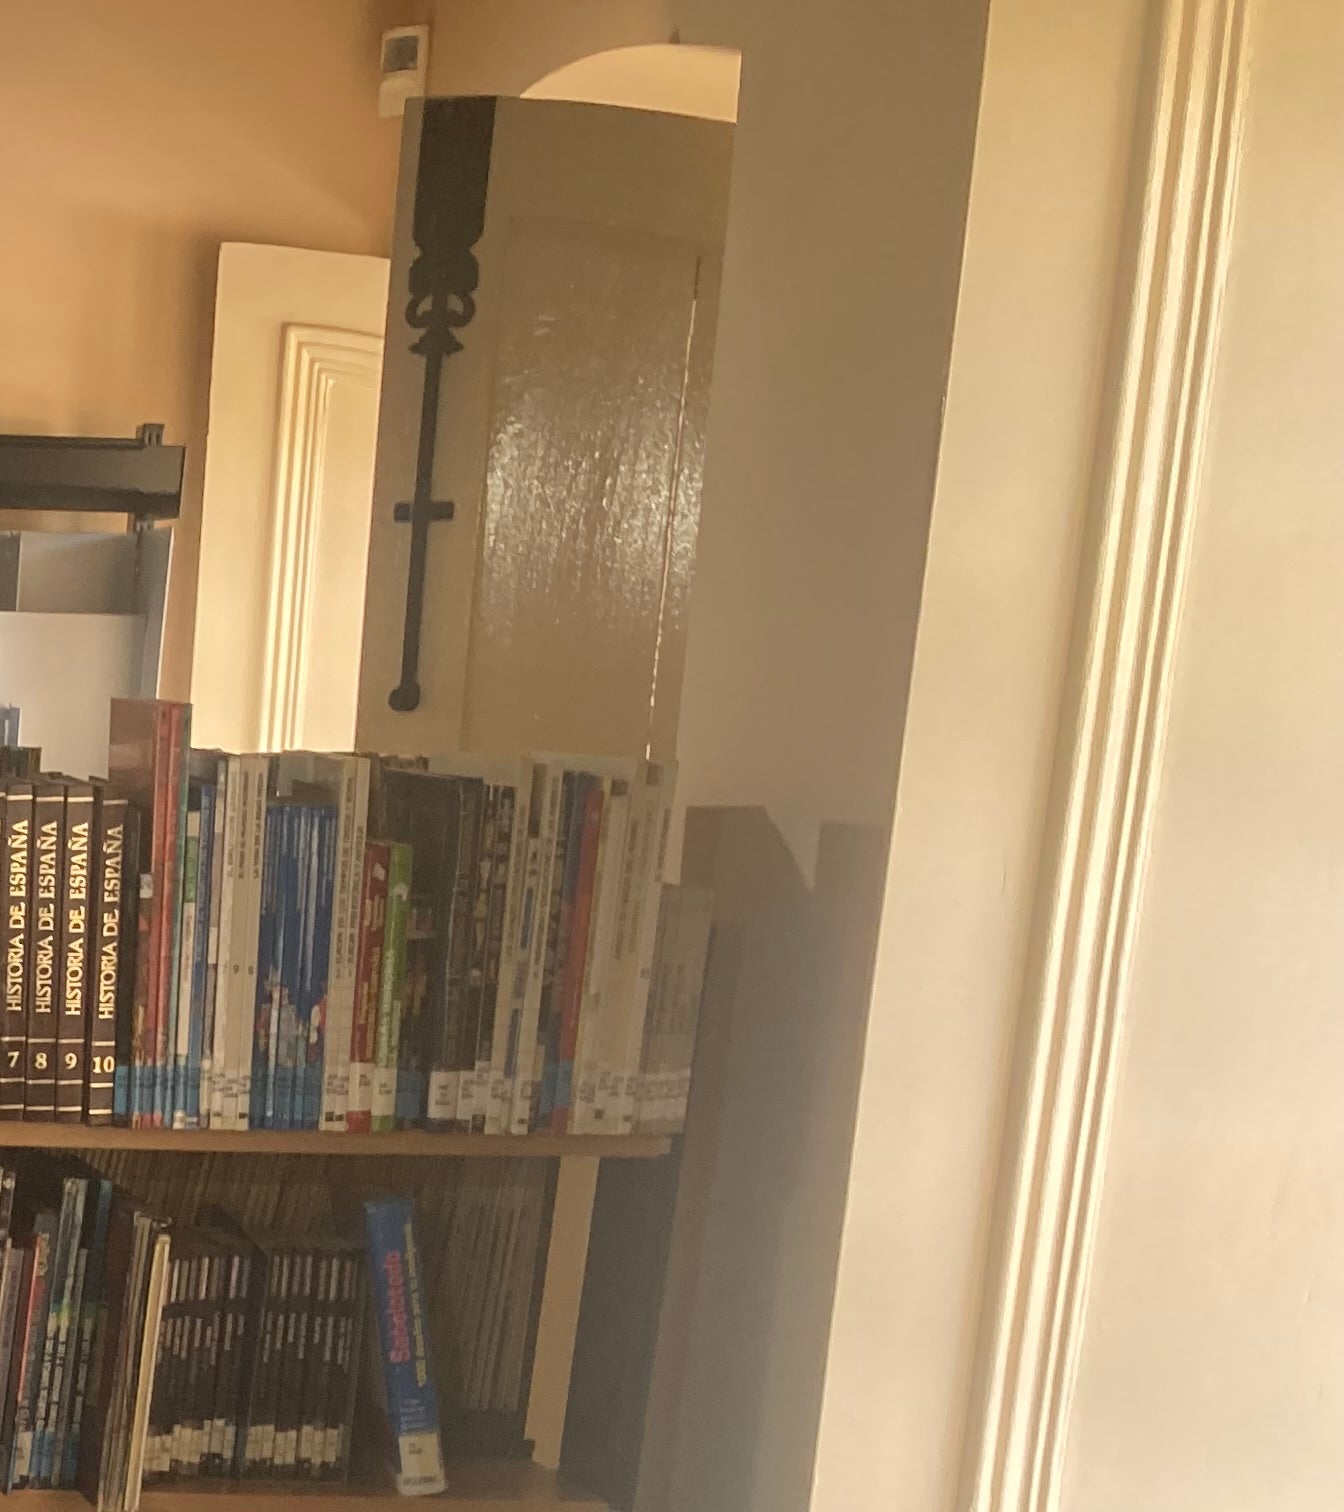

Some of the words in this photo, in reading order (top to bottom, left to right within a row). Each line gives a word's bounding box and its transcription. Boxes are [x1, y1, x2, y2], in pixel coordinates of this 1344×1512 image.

[6, 818, 28, 898] ESPAÑA
[35, 819, 57, 900] ESPAÑA
[66, 821, 89, 900] ESPAÑA
[99, 822, 123, 903] ESPAÑA
[9, 901, 27, 930] DE
[37, 903, 56, 932] DE
[68, 905, 87, 934] DE
[101, 909, 120, 938] DE
[8, 932, 27, 1012] HISTORIA
[36, 934, 55, 1014] HISTORIA
[66, 936, 86, 1016] HISTORIA
[98, 940, 119, 1020] HISTORIA
[8, 1051, 20, 1068] 7
[35, 1052, 48, 1070] 8
[64, 1053, 77, 1070] 9
[92, 1056, 115, 1074] 10
